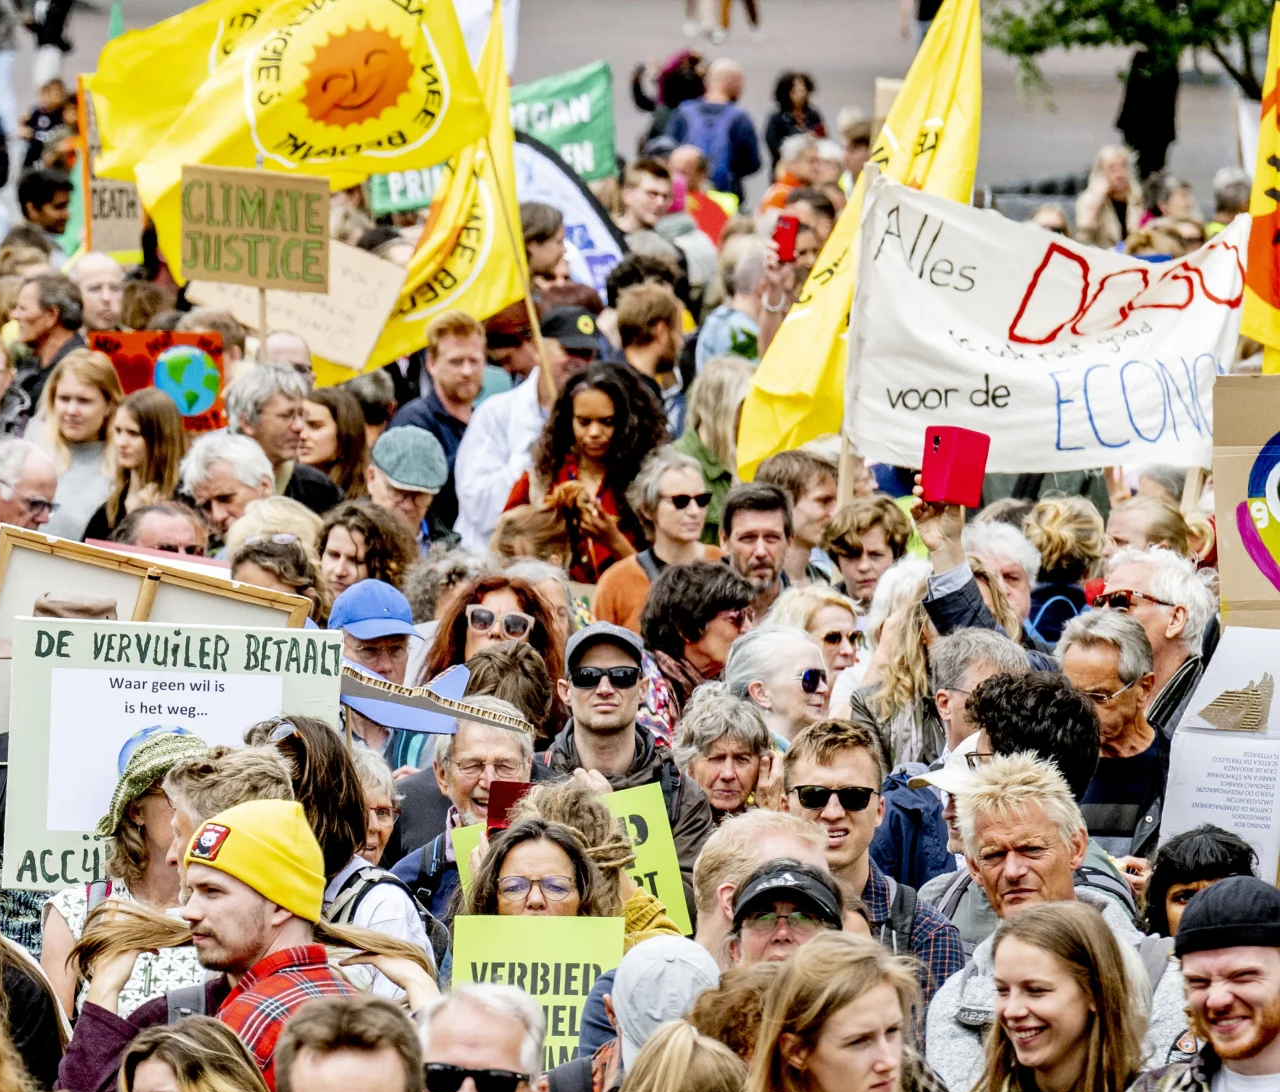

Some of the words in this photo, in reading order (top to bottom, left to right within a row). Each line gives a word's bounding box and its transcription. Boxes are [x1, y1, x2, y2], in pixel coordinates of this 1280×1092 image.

[182, 179, 324, 235] CLIMATE
[183, 230, 324, 284] JUSTICE
[873, 204, 977, 292] Alles
[885, 383, 960, 411] voor
[968, 372, 1012, 411] de
[34, 629, 75, 659] DE
[243, 633, 341, 677] BETAALT
[109, 676, 149, 691] Waar
[151, 679, 186, 694] geen
[189, 680, 211, 693] wil
[214, 680, 226, 693] is
[124, 702, 136, 715] is
[139, 702, 163, 716] het
[167, 704, 209, 718] weg...
[470, 961, 602, 996] VERBIED
